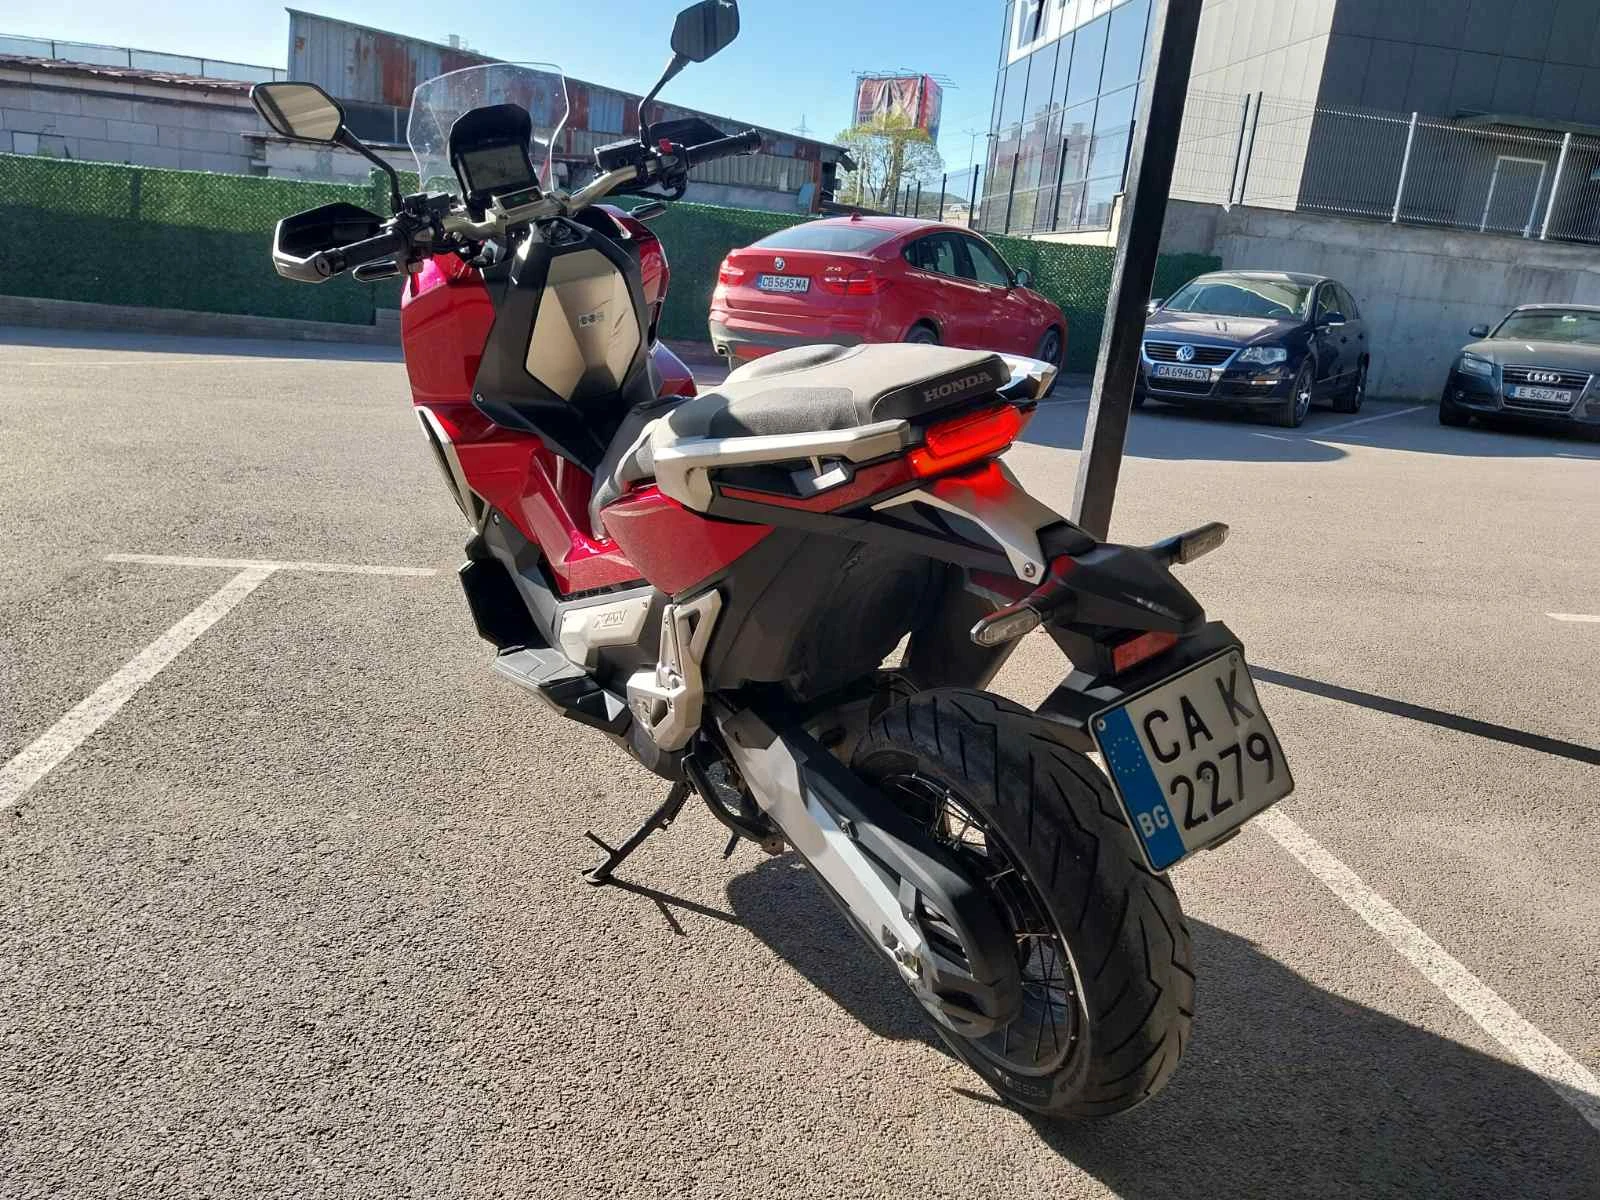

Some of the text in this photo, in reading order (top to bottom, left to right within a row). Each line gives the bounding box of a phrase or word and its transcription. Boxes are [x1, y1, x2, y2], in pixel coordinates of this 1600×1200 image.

[923, 371, 993, 402] HONDA
[1158, 366, 1208, 379] CA 6946 CX
[1530, 388, 1554, 400] 5627
[1143, 669, 1255, 763] CA K
[1170, 731, 1274, 830] 2279
[1137, 805, 1169, 838] BG
